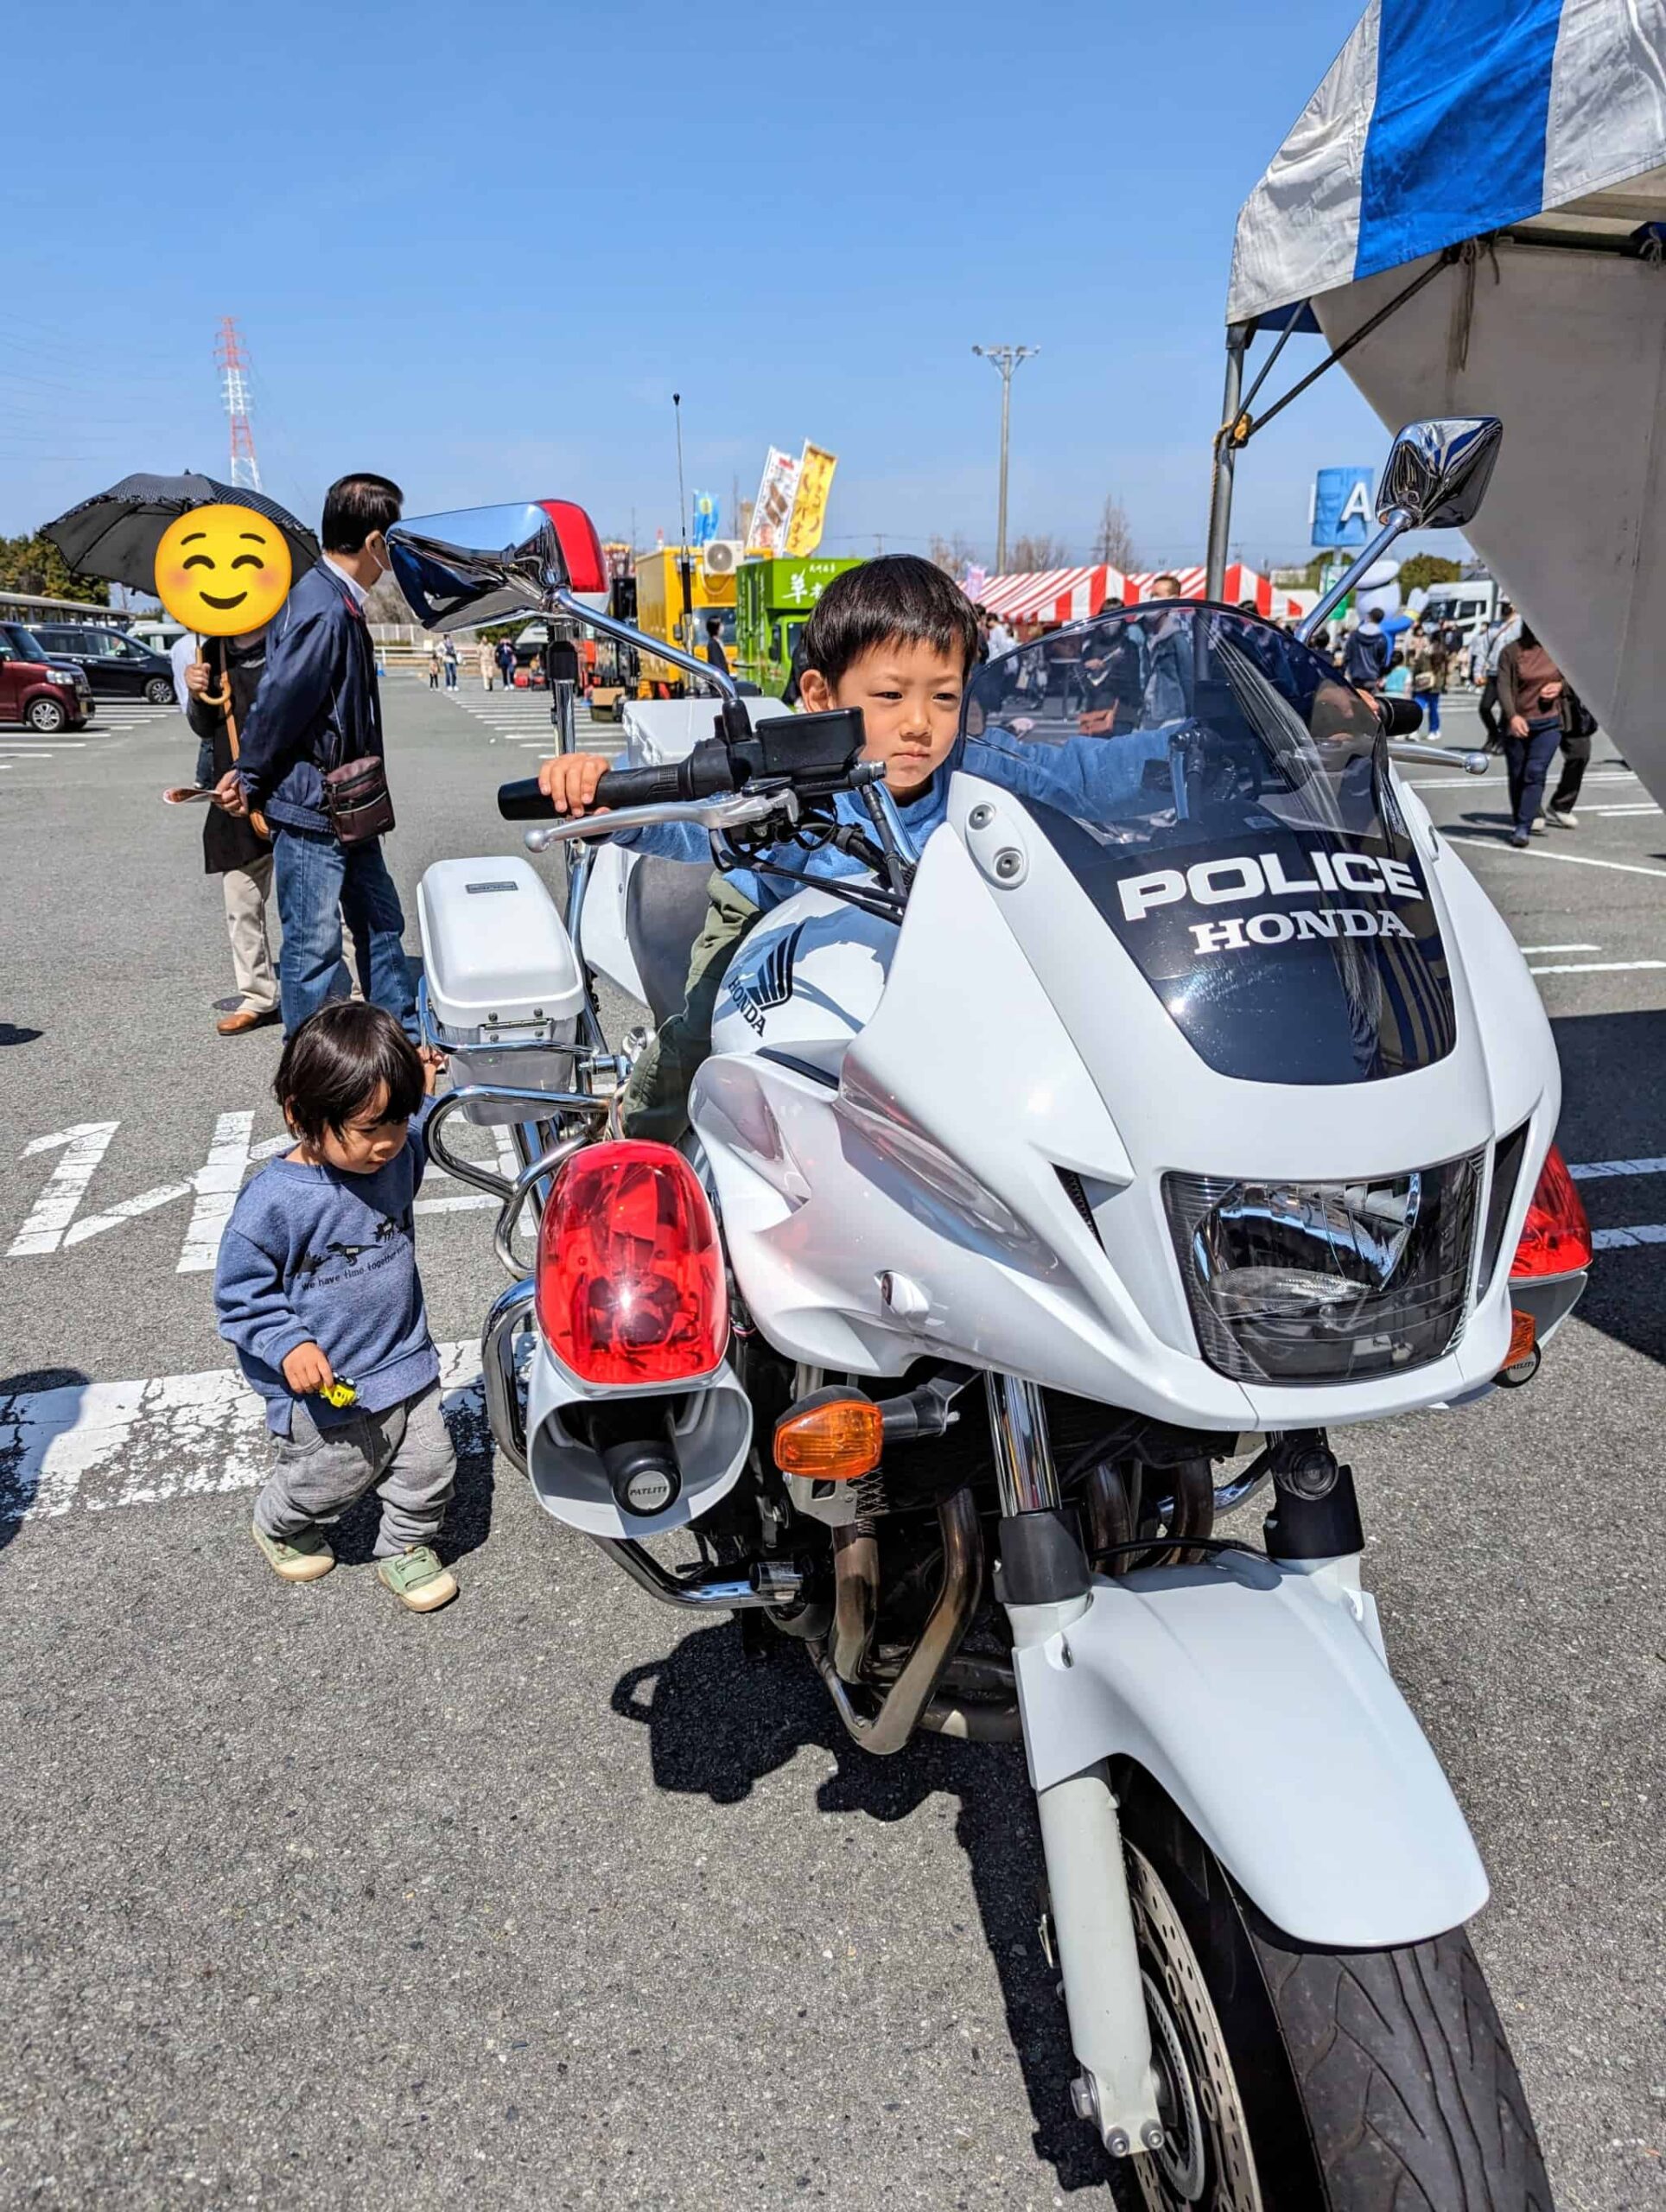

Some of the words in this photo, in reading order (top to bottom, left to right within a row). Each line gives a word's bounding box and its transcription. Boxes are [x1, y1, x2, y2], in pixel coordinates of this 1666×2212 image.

[1341, 482, 1373, 522] A
[1117, 851, 1425, 921] POLICE
[1189, 908, 1415, 956] HONDA
[728, 976, 766, 1037] HONDA
[318, 1274, 340, 1287] have
